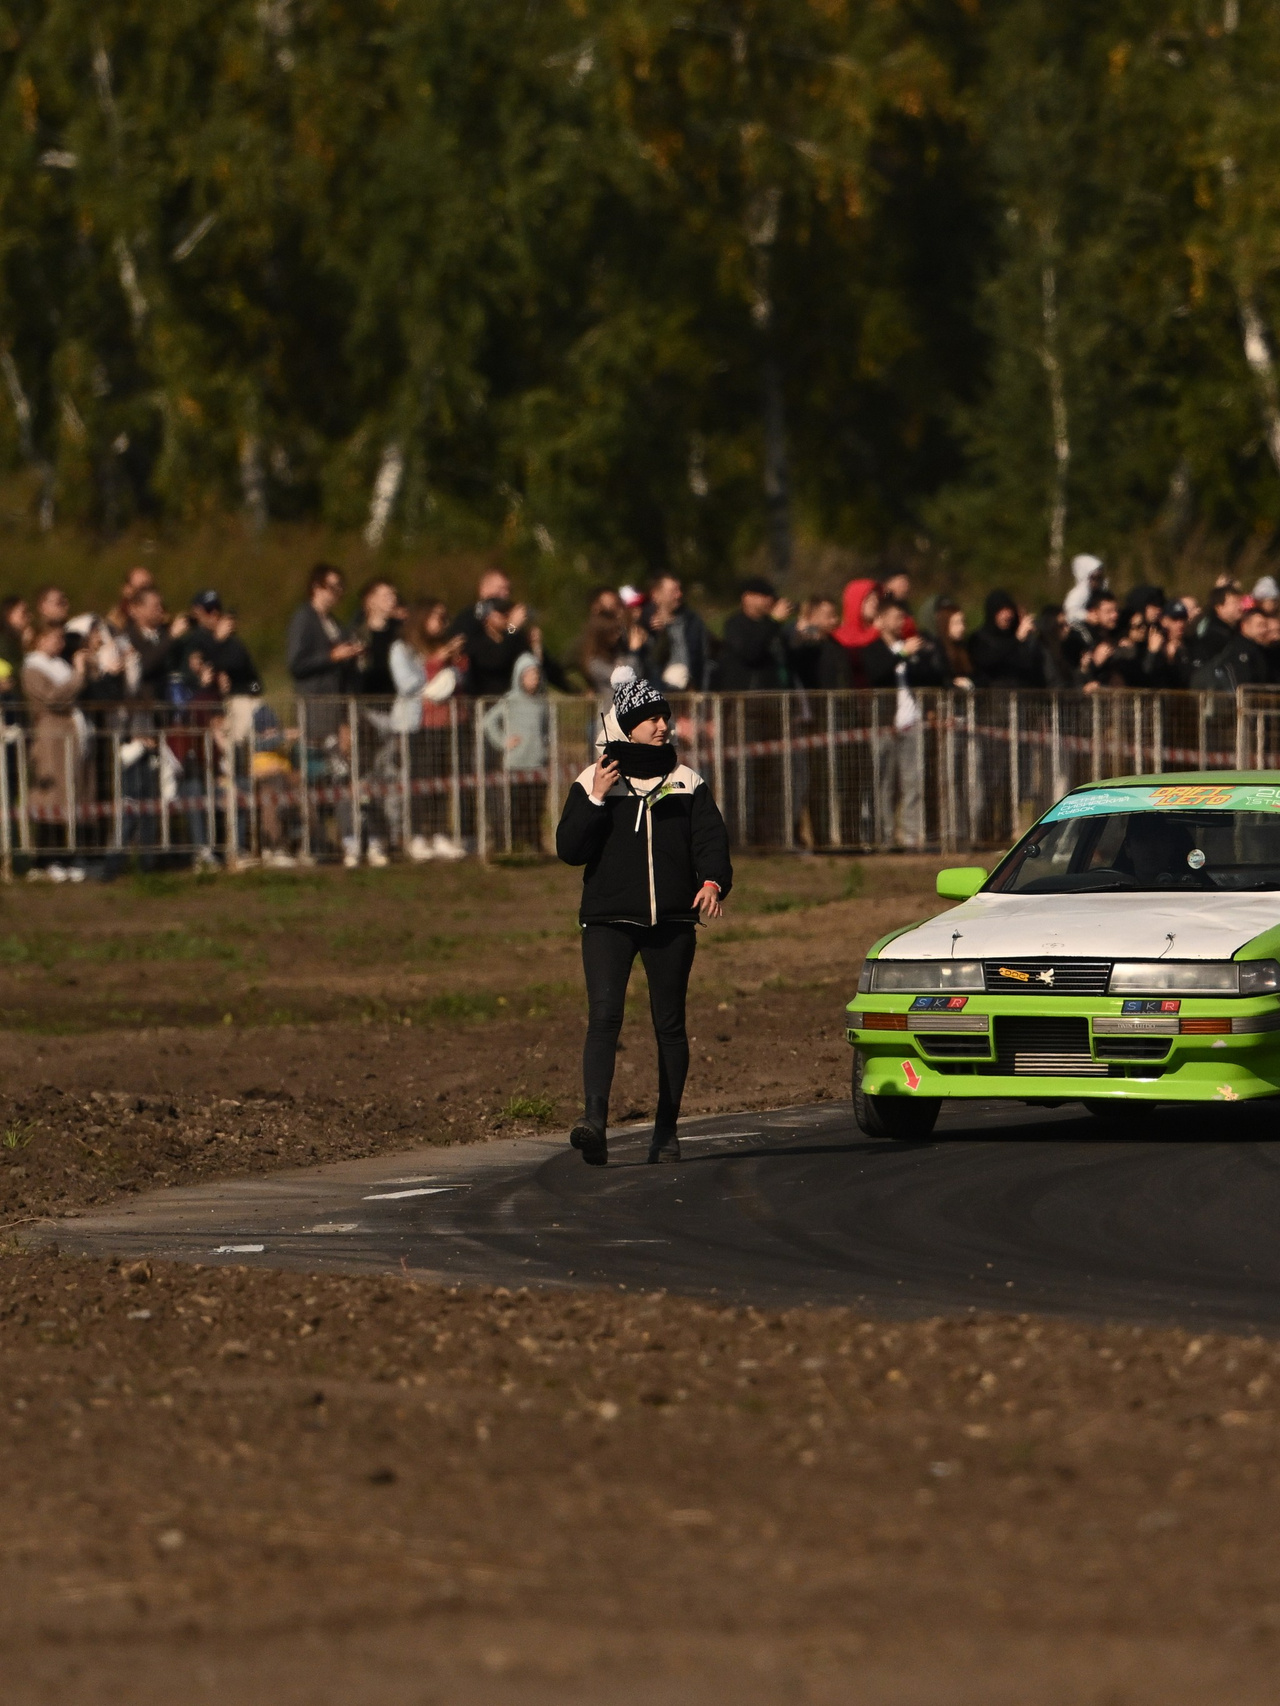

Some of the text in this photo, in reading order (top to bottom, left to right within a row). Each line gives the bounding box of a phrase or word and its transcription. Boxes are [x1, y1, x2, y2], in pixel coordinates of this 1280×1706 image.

[1149, 786, 1236, 798] DRIFT
[1154, 794, 1233, 806] LETO
[1057, 805, 1096, 816] КУБОК
[916, 998, 963, 1008] SKR
[1127, 1001, 1175, 1011] SKR
